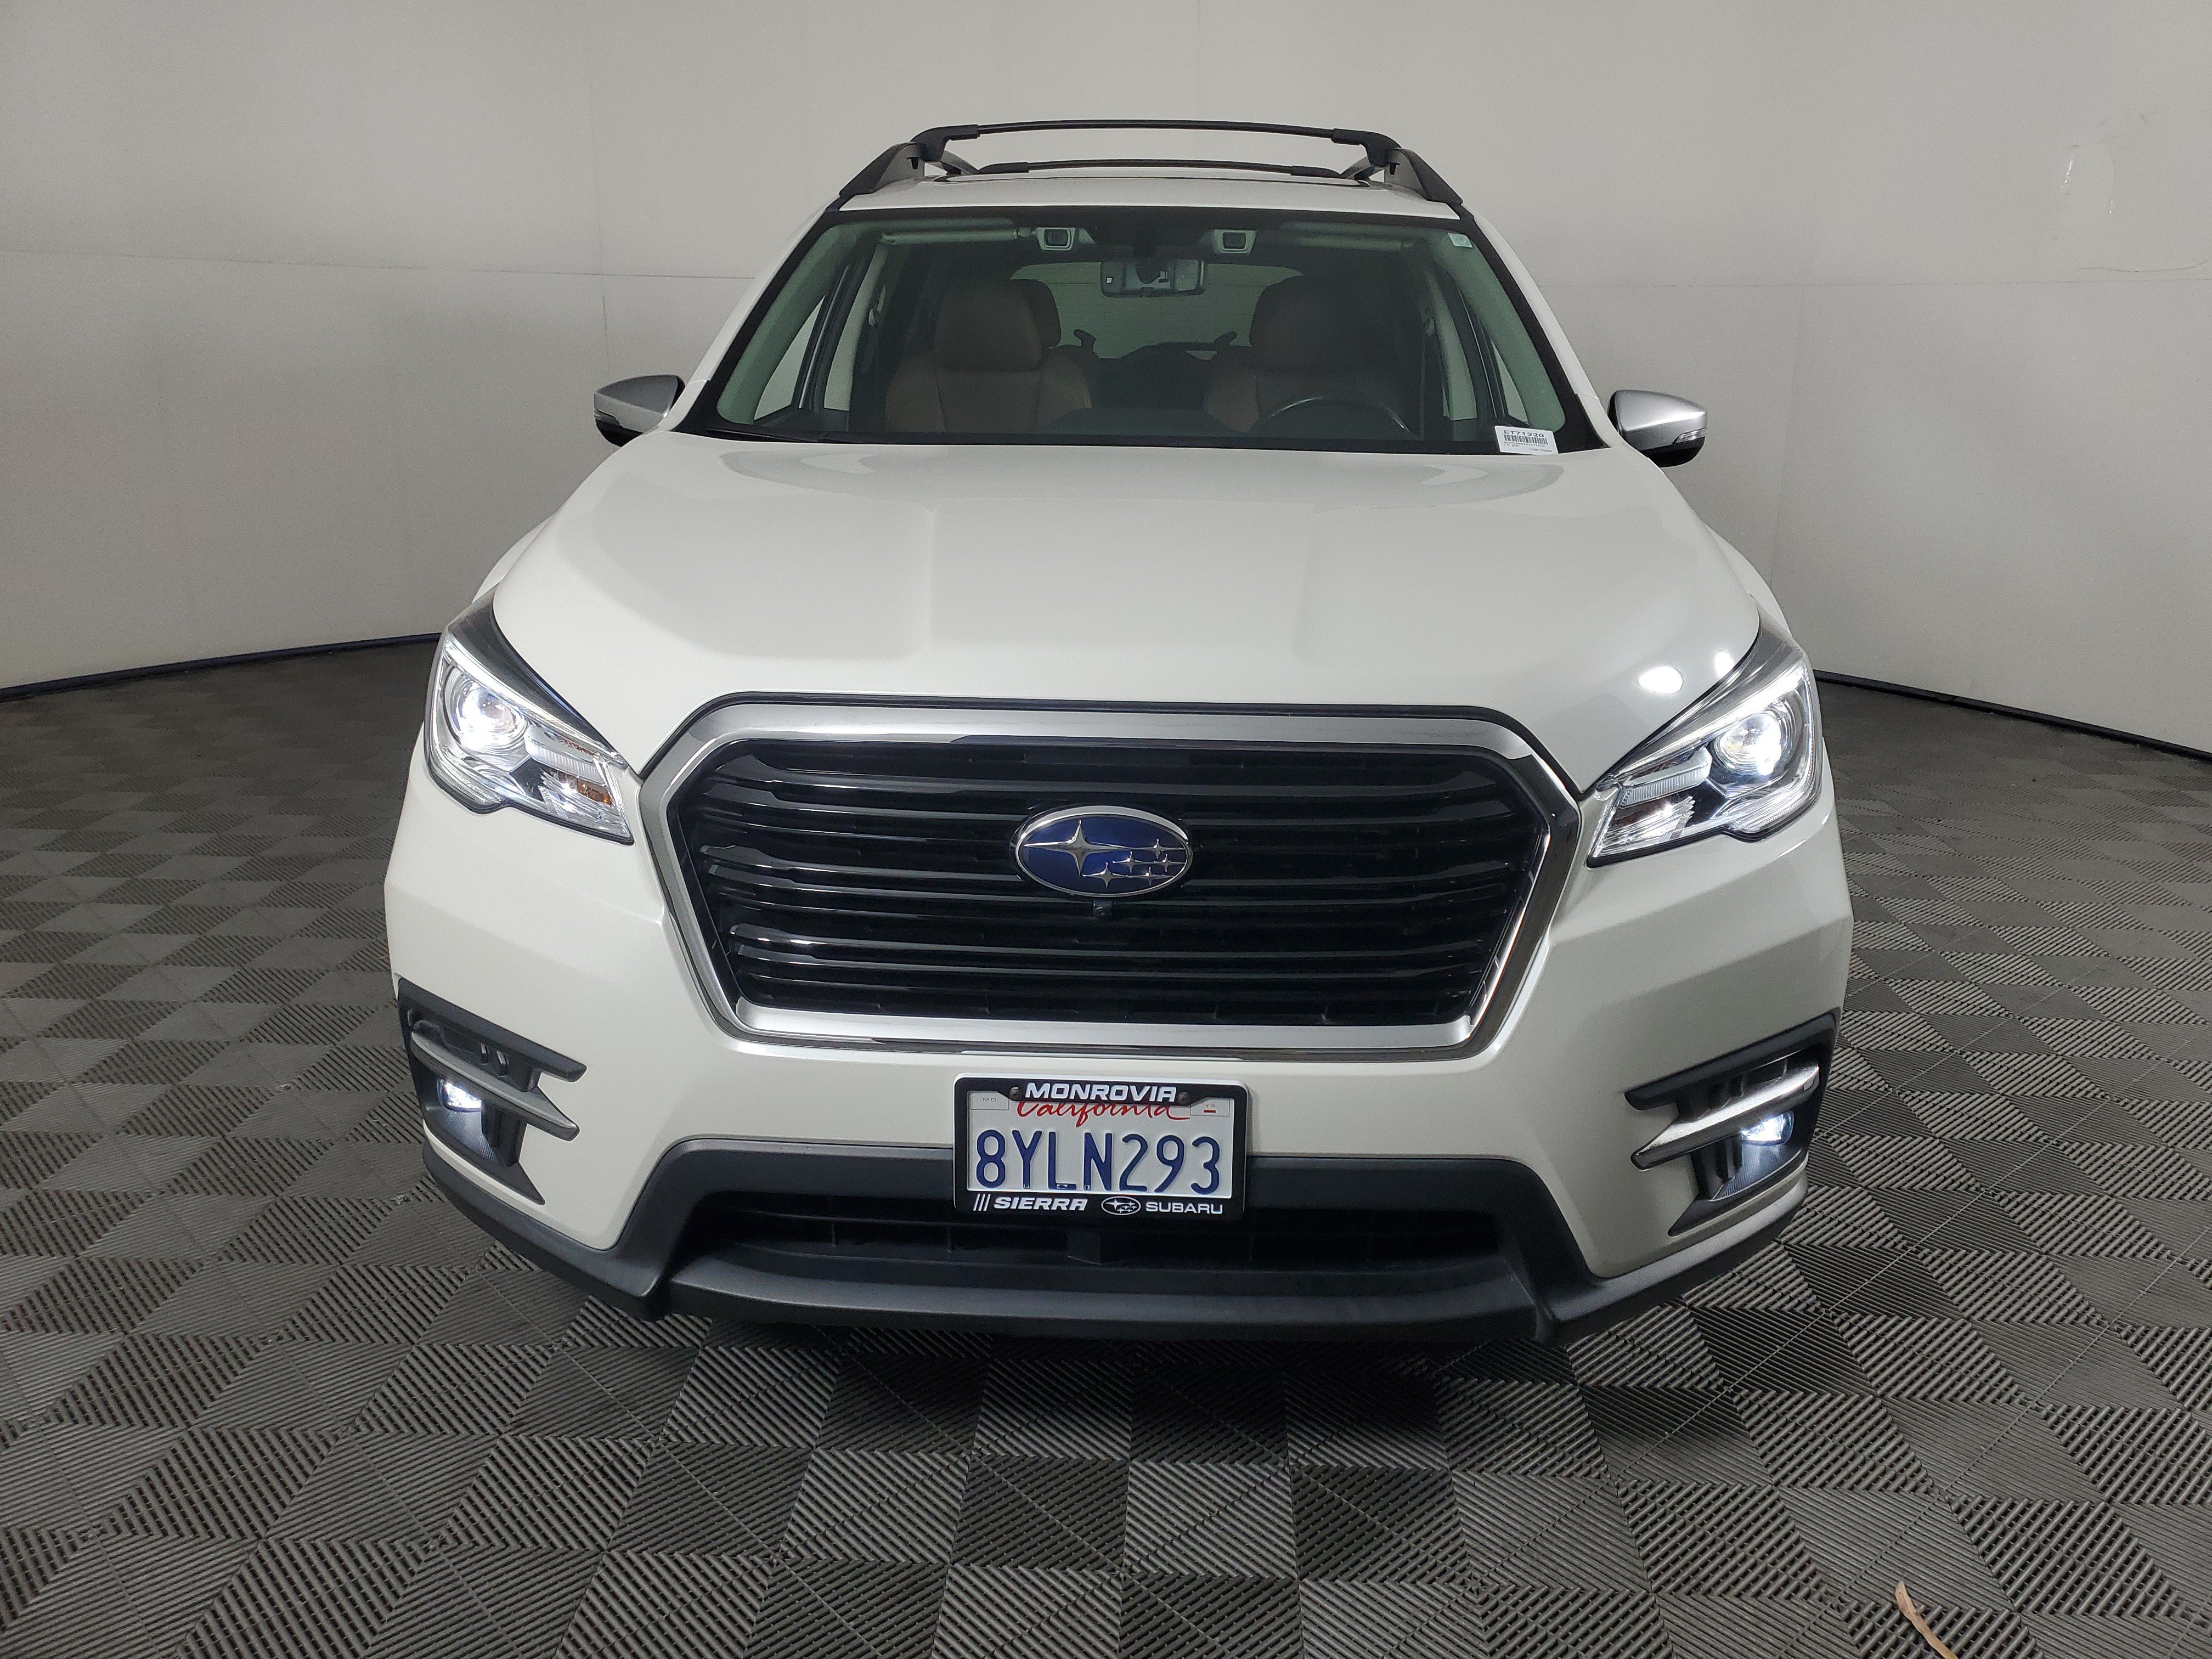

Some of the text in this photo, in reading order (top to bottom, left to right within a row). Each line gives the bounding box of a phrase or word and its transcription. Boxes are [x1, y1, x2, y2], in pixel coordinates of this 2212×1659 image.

[1025, 1082, 1177, 1103] MONROVIA
[1017, 1100, 1190, 1127] California
[975, 1129, 1221, 1195] 8YLN293
[994, 1197, 1223, 1214] SIERRA SUBARU
